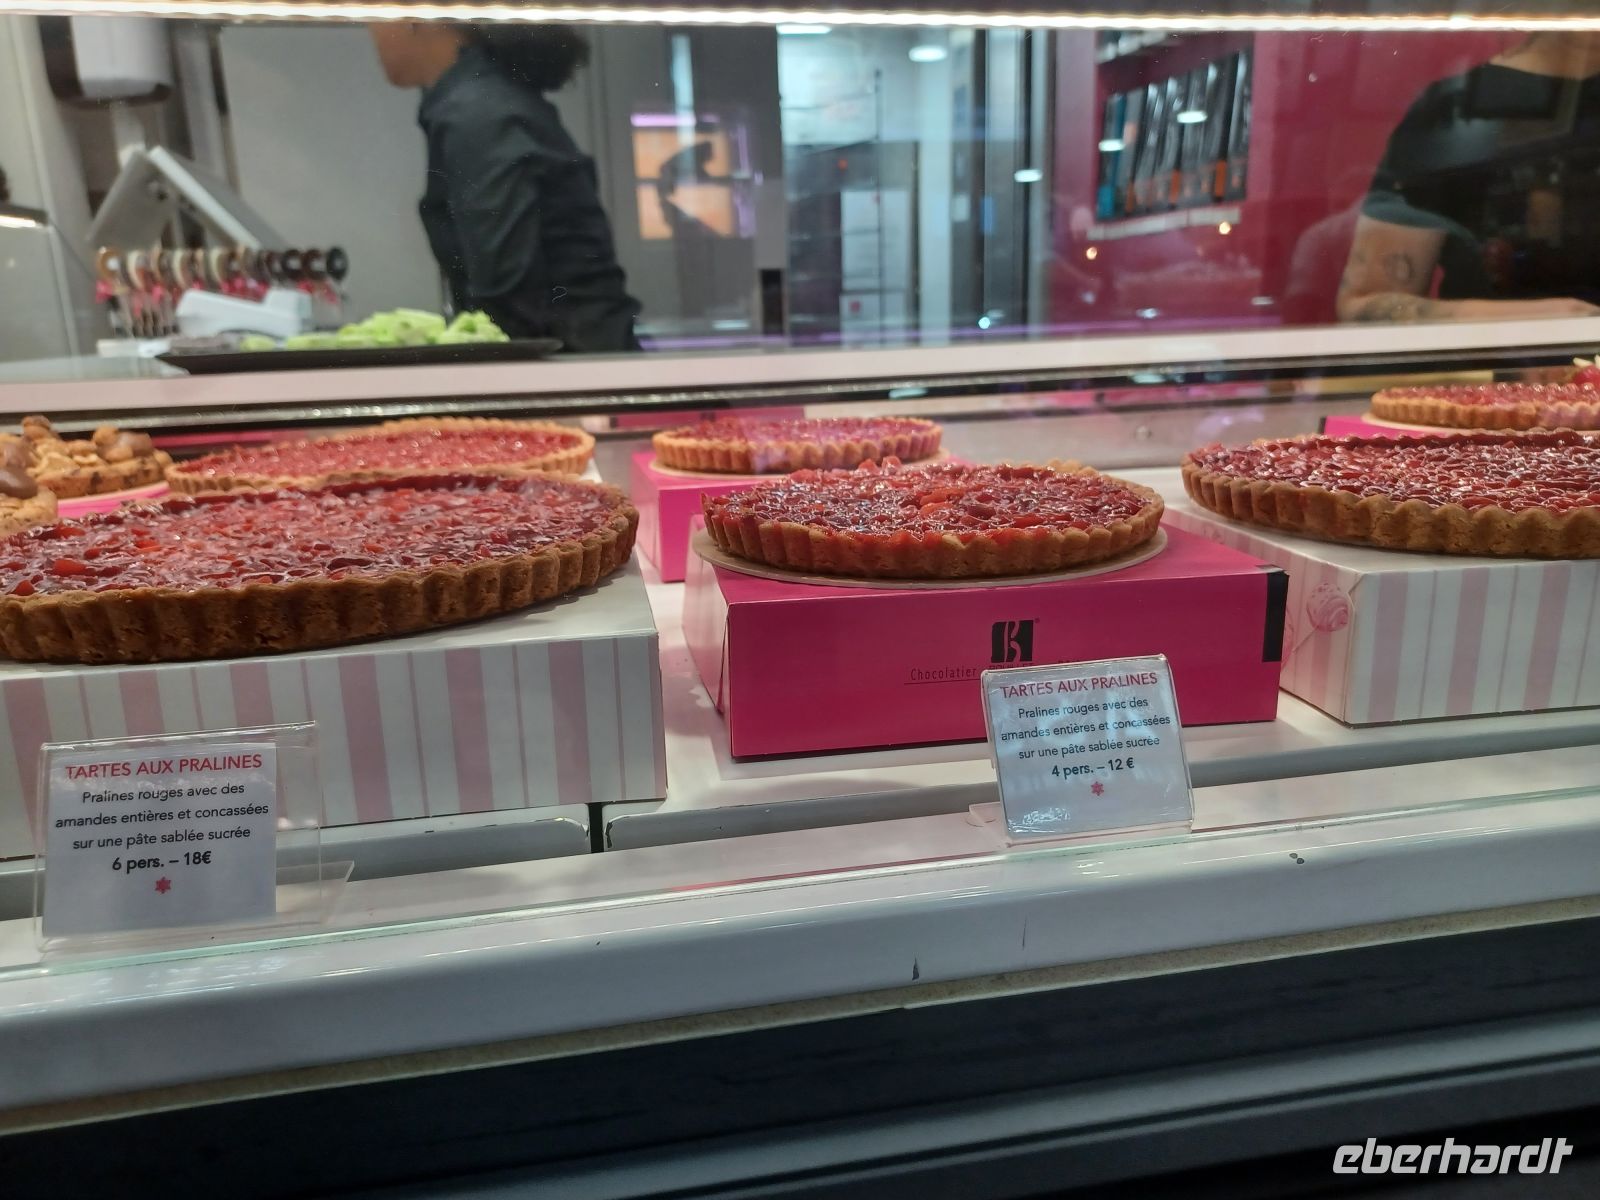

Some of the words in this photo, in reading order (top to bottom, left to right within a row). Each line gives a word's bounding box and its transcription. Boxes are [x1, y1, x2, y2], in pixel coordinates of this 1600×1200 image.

[911, 668, 976, 681] Chocolatier
[1000, 682, 1053, 699] TARTES
[1058, 678, 1088, 693] AUX
[1092, 672, 1158, 690] PRALINES
[1018, 706, 1060, 719] Pralines
[1063, 704, 1099, 717] rouges
[1102, 701, 1126, 710] avec
[1129, 698, 1148, 708] des
[1001, 728, 1050, 741] amandes
[1053, 723, 1095, 736] entières
[1099, 723, 1109, 731] et
[1113, 715, 1171, 729] concassées
[1019, 750, 1035, 759] sur
[1038, 748, 1058, 757] une
[1062, 743, 1085, 759] pâte
[1089, 739, 1123, 751] sablée
[1126, 736, 1160, 748] sucrée
[66, 763, 131, 780] TARTES
[136, 760, 173, 775] AUX
[179, 754, 262, 773] PRALINES
[1052, 765, 1059, 777] 4
[1063, 764, 1093, 779] pers.
[1108, 759, 1123, 771] 12
[1126, 757, 1135, 768] €
[82, 790, 134, 804] Pralines
[138, 788, 183, 802] rouges
[187, 786, 217, 796] avec
[221, 783, 245, 795] des
[55, 813, 117, 828] amandes
[121, 809, 174, 822] entières
[178, 809, 191, 819] et
[195, 803, 269, 818] concassées
[73, 839, 93, 850] sur
[98, 837, 122, 847] une
[127, 832, 157, 850] pâte
[161, 830, 204, 843] sablée
[208, 826, 251, 840] sucrée
[112, 857, 122, 871] 6
[127, 855, 165, 874] pers.
[184, 851, 212, 865] 18€
